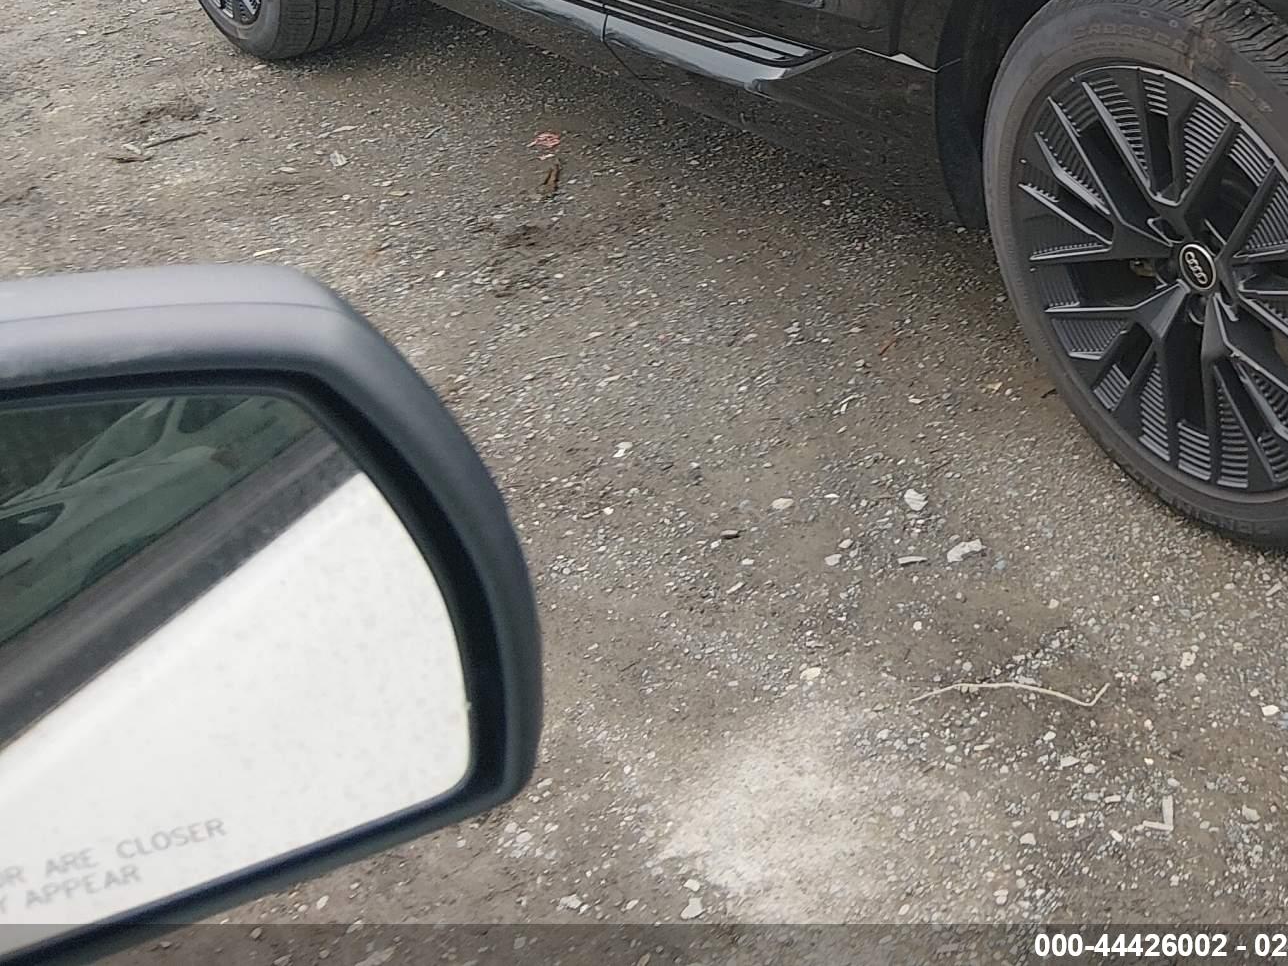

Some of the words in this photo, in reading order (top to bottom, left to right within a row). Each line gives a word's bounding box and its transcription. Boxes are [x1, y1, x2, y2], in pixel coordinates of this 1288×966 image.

[45, 847, 99, 878] ARE
[116, 818, 227, 859] CLOSER
[25, 863, 141, 909] APPEAR
